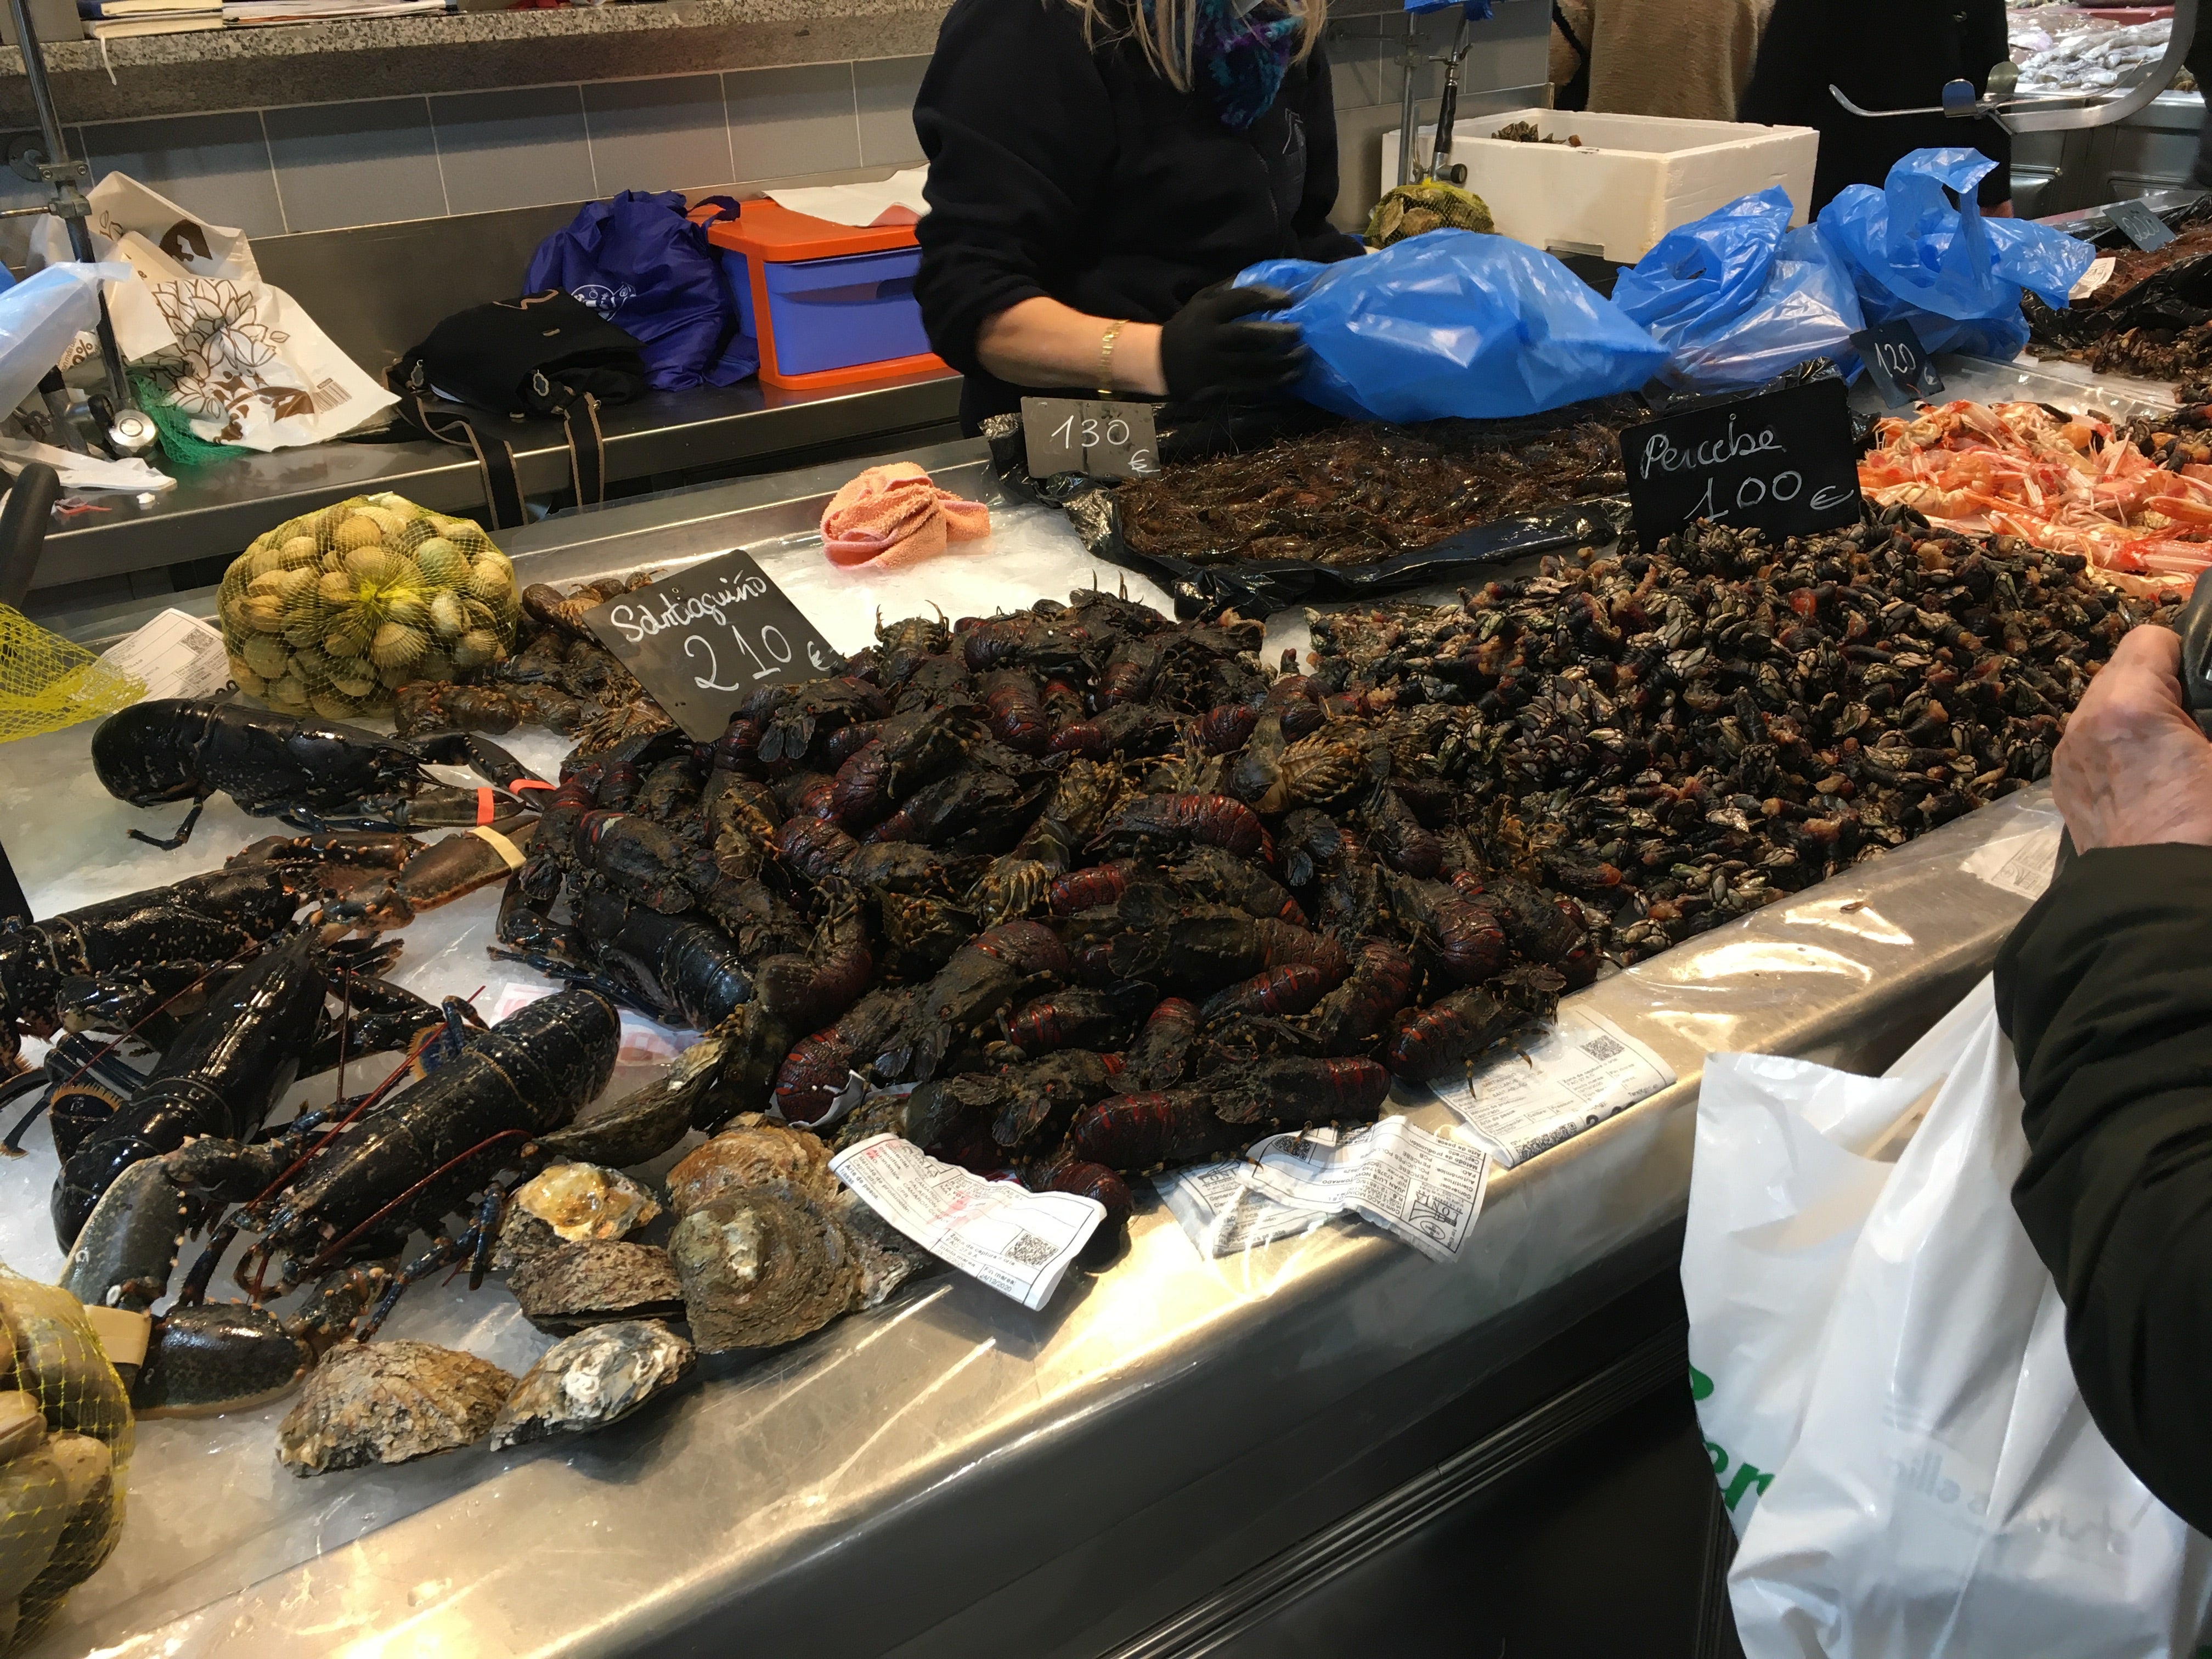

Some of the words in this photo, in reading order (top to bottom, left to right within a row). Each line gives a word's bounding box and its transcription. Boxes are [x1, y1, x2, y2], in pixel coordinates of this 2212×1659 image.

[1875, 343, 1916, 379] 120
[1051, 415, 1130, 449] 130
[1127, 449, 1161, 477] €
[1640, 421, 1783, 479] Percebe
[1683, 471, 1803, 522] 100
[1809, 485, 1854, 511] €
[610, 569, 768, 643] Santiaguiño
[684, 624, 792, 692] 210
[1397, 1165, 1429, 1181] PERCEBE
[1402, 1150, 1431, 1169] PERCEBE
[1454, 1157, 1479, 1170] Método
